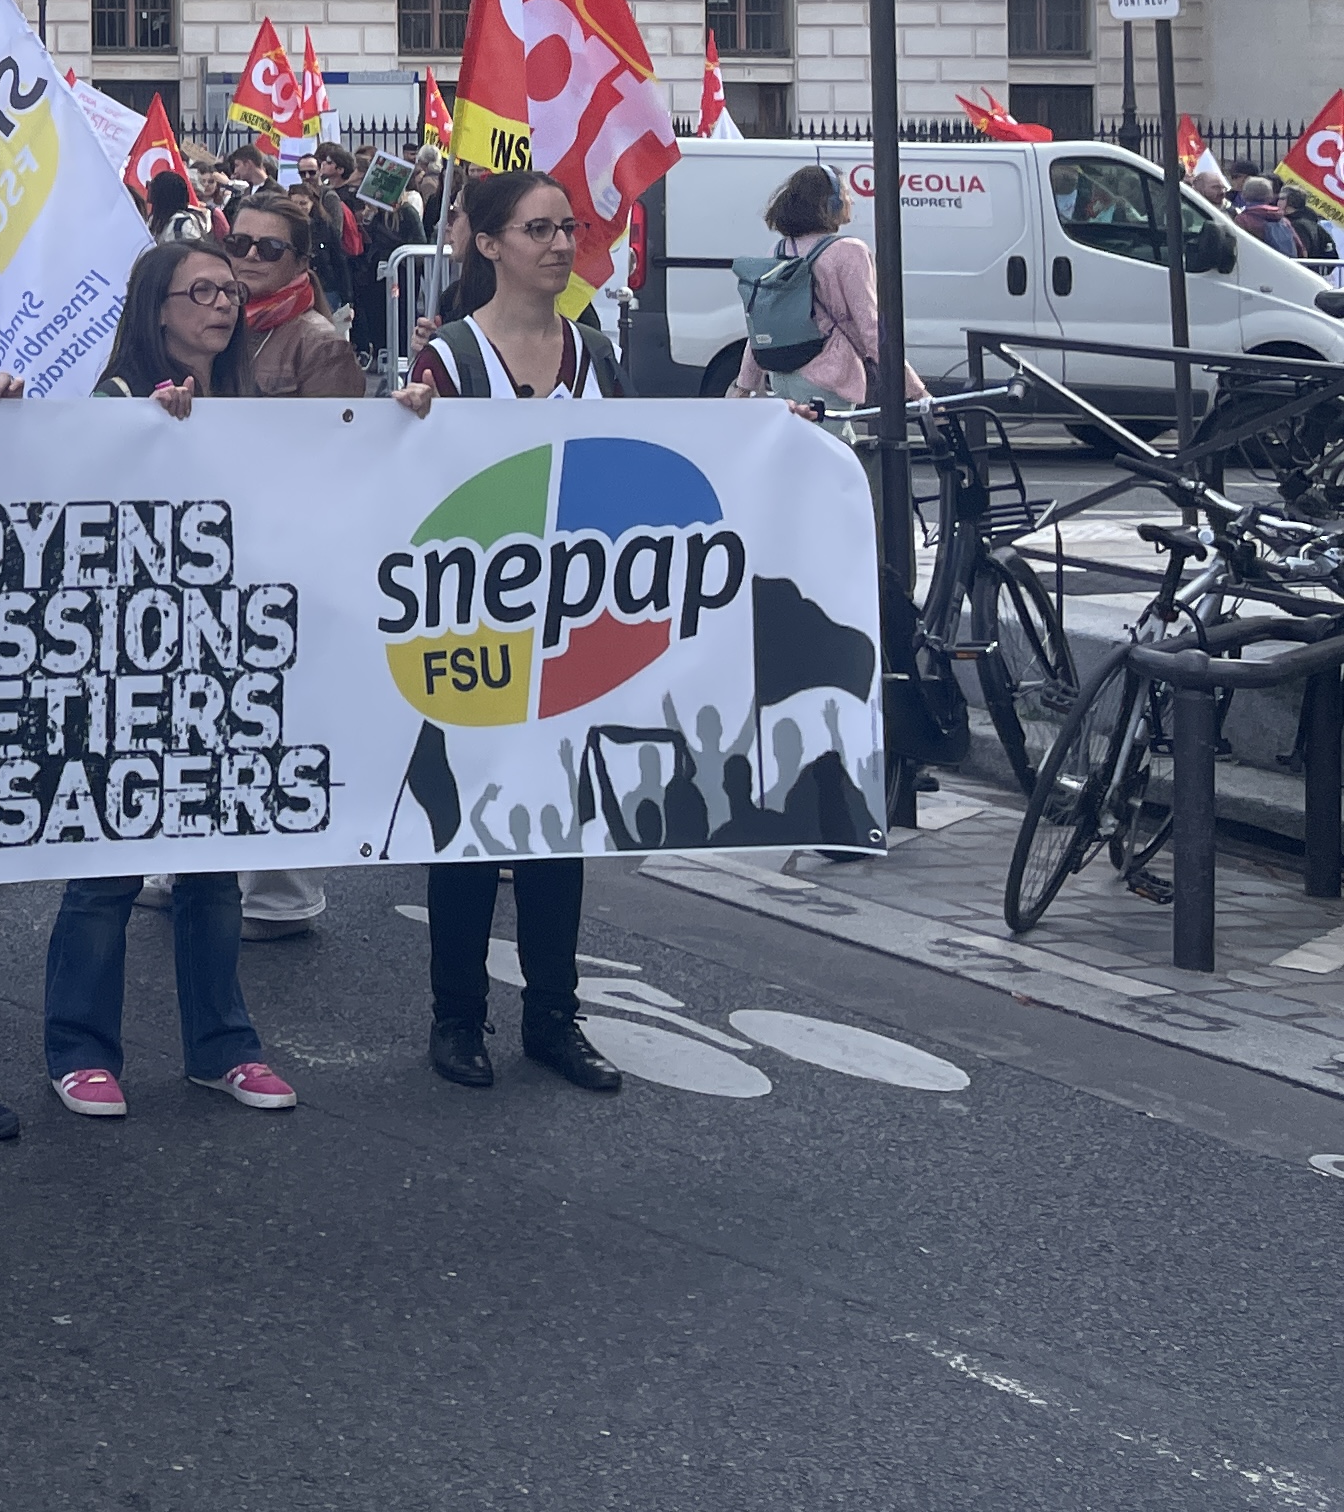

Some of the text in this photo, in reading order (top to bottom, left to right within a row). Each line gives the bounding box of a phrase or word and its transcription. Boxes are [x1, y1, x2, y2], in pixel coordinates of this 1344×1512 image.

[900, 195, 963, 209] ROPRETÉ
[377, 529, 746, 650] snepap
[422, 643, 512, 695] FSU
